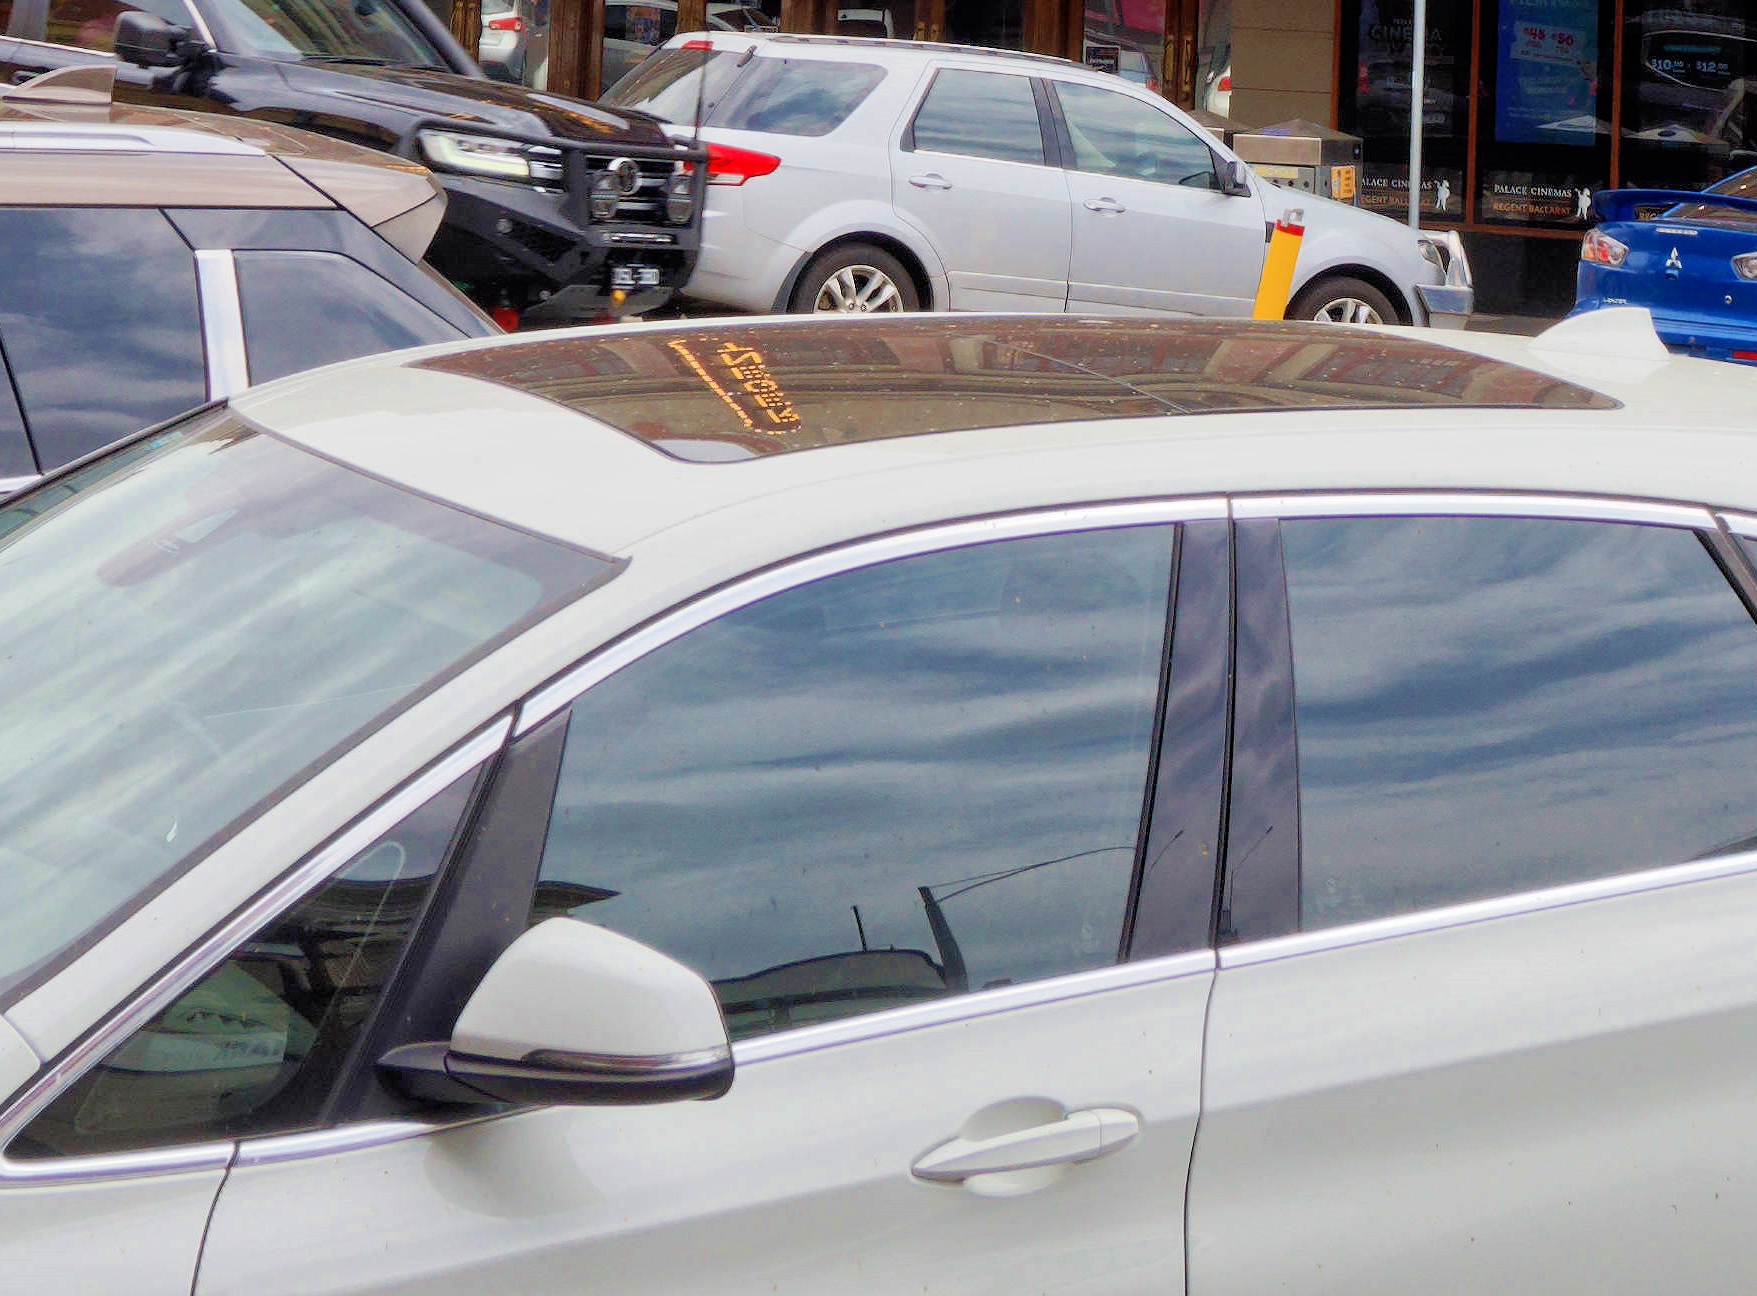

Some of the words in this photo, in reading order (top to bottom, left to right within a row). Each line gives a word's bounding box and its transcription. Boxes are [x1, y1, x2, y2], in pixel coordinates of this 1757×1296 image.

[1361, 176, 1389, 188] ALACE
[1494, 183, 1527, 196] PALACE
[1530, 186, 1572, 199] CINEMAS
[1492, 201, 1528, 214] REGENT
